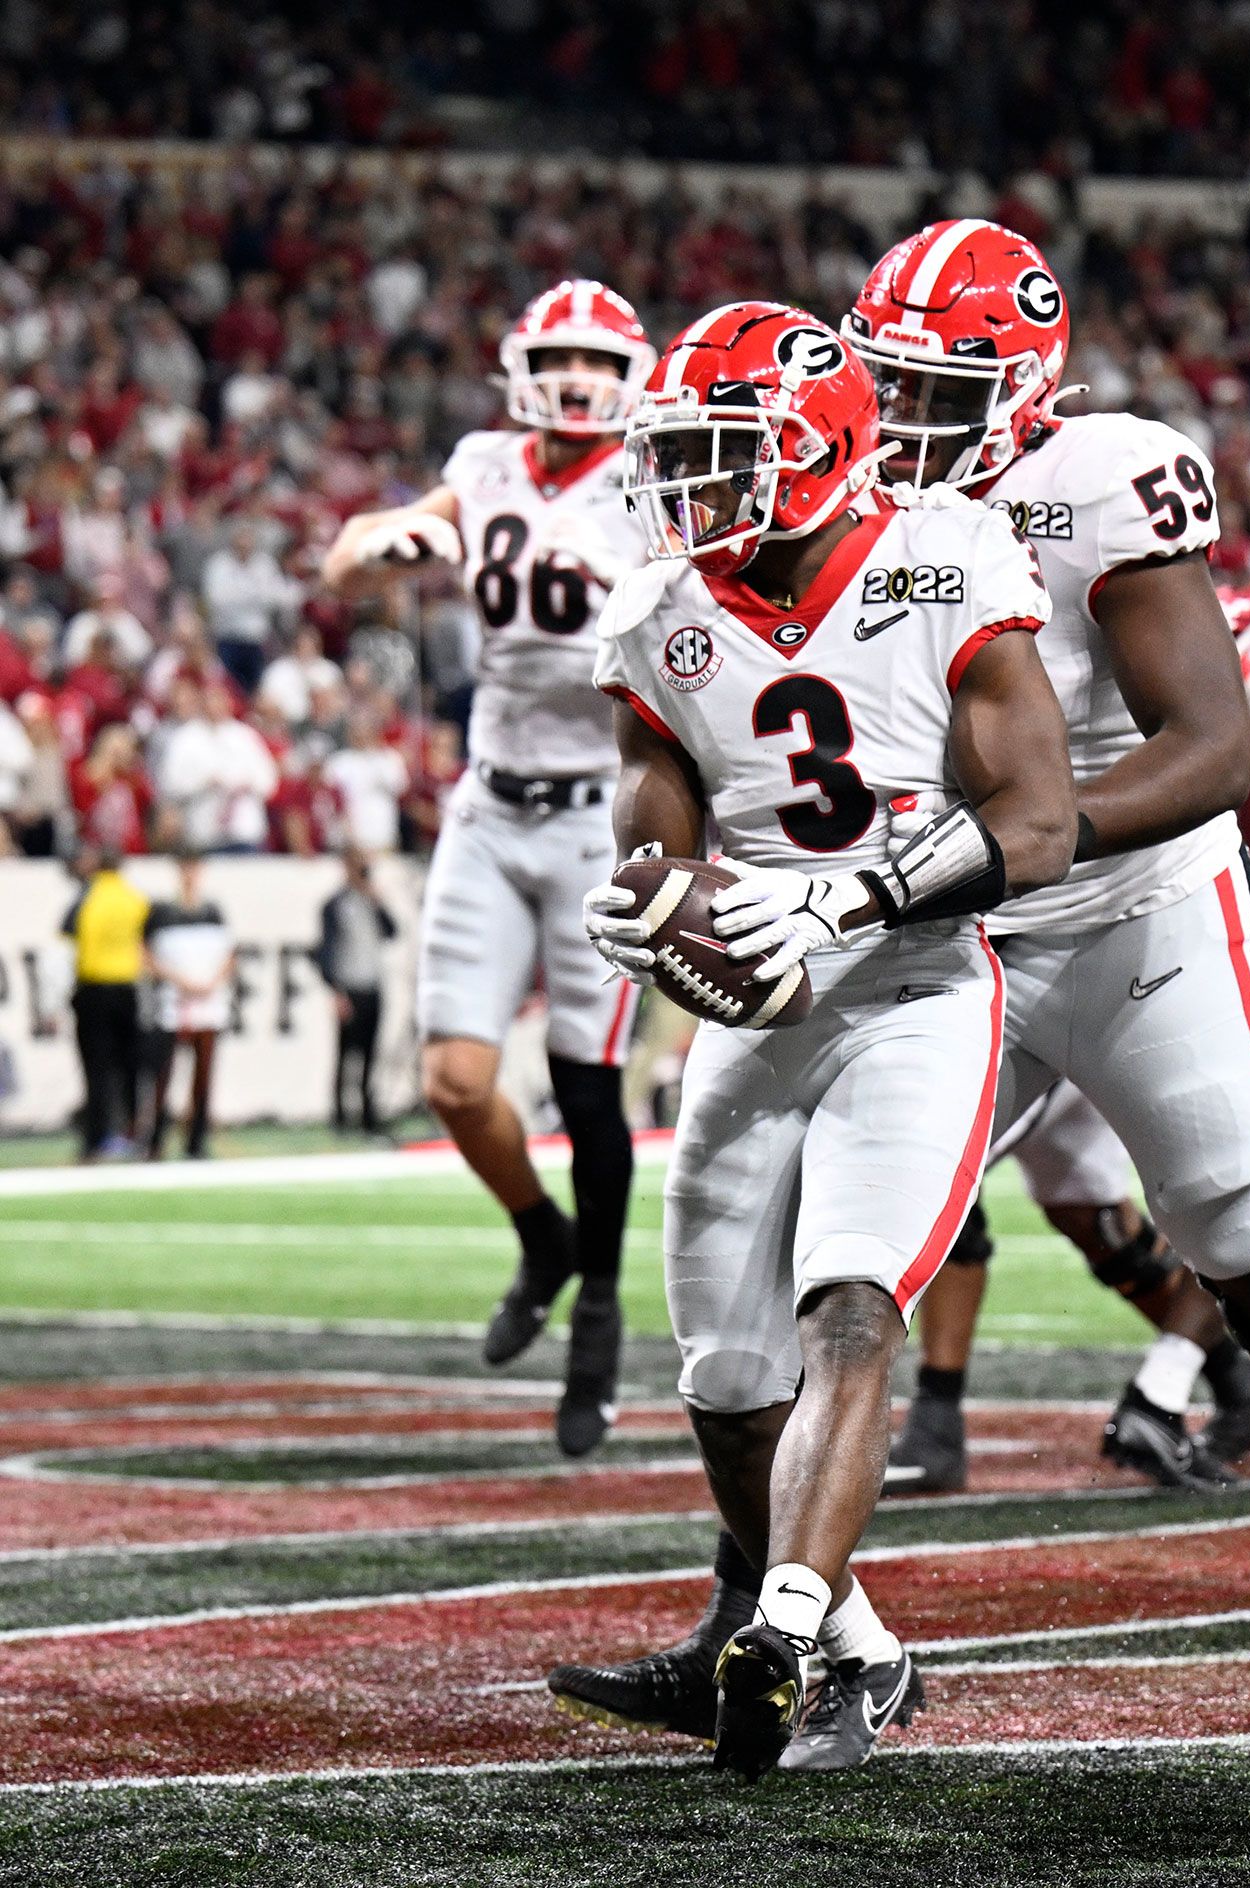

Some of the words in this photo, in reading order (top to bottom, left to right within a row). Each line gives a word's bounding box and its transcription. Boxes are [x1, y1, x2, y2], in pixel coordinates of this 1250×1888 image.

[1016, 270, 1062, 323] G
[777, 328, 844, 378] G
[1131, 453, 1215, 541] 59
[475, 514, 591, 636] 86
[862, 565, 964, 604] 2022
[667, 628, 710, 675] SEC
[773, 622, 807, 647] G
[667, 667, 715, 691] GRADUATE
[752, 673, 877, 853] 3
